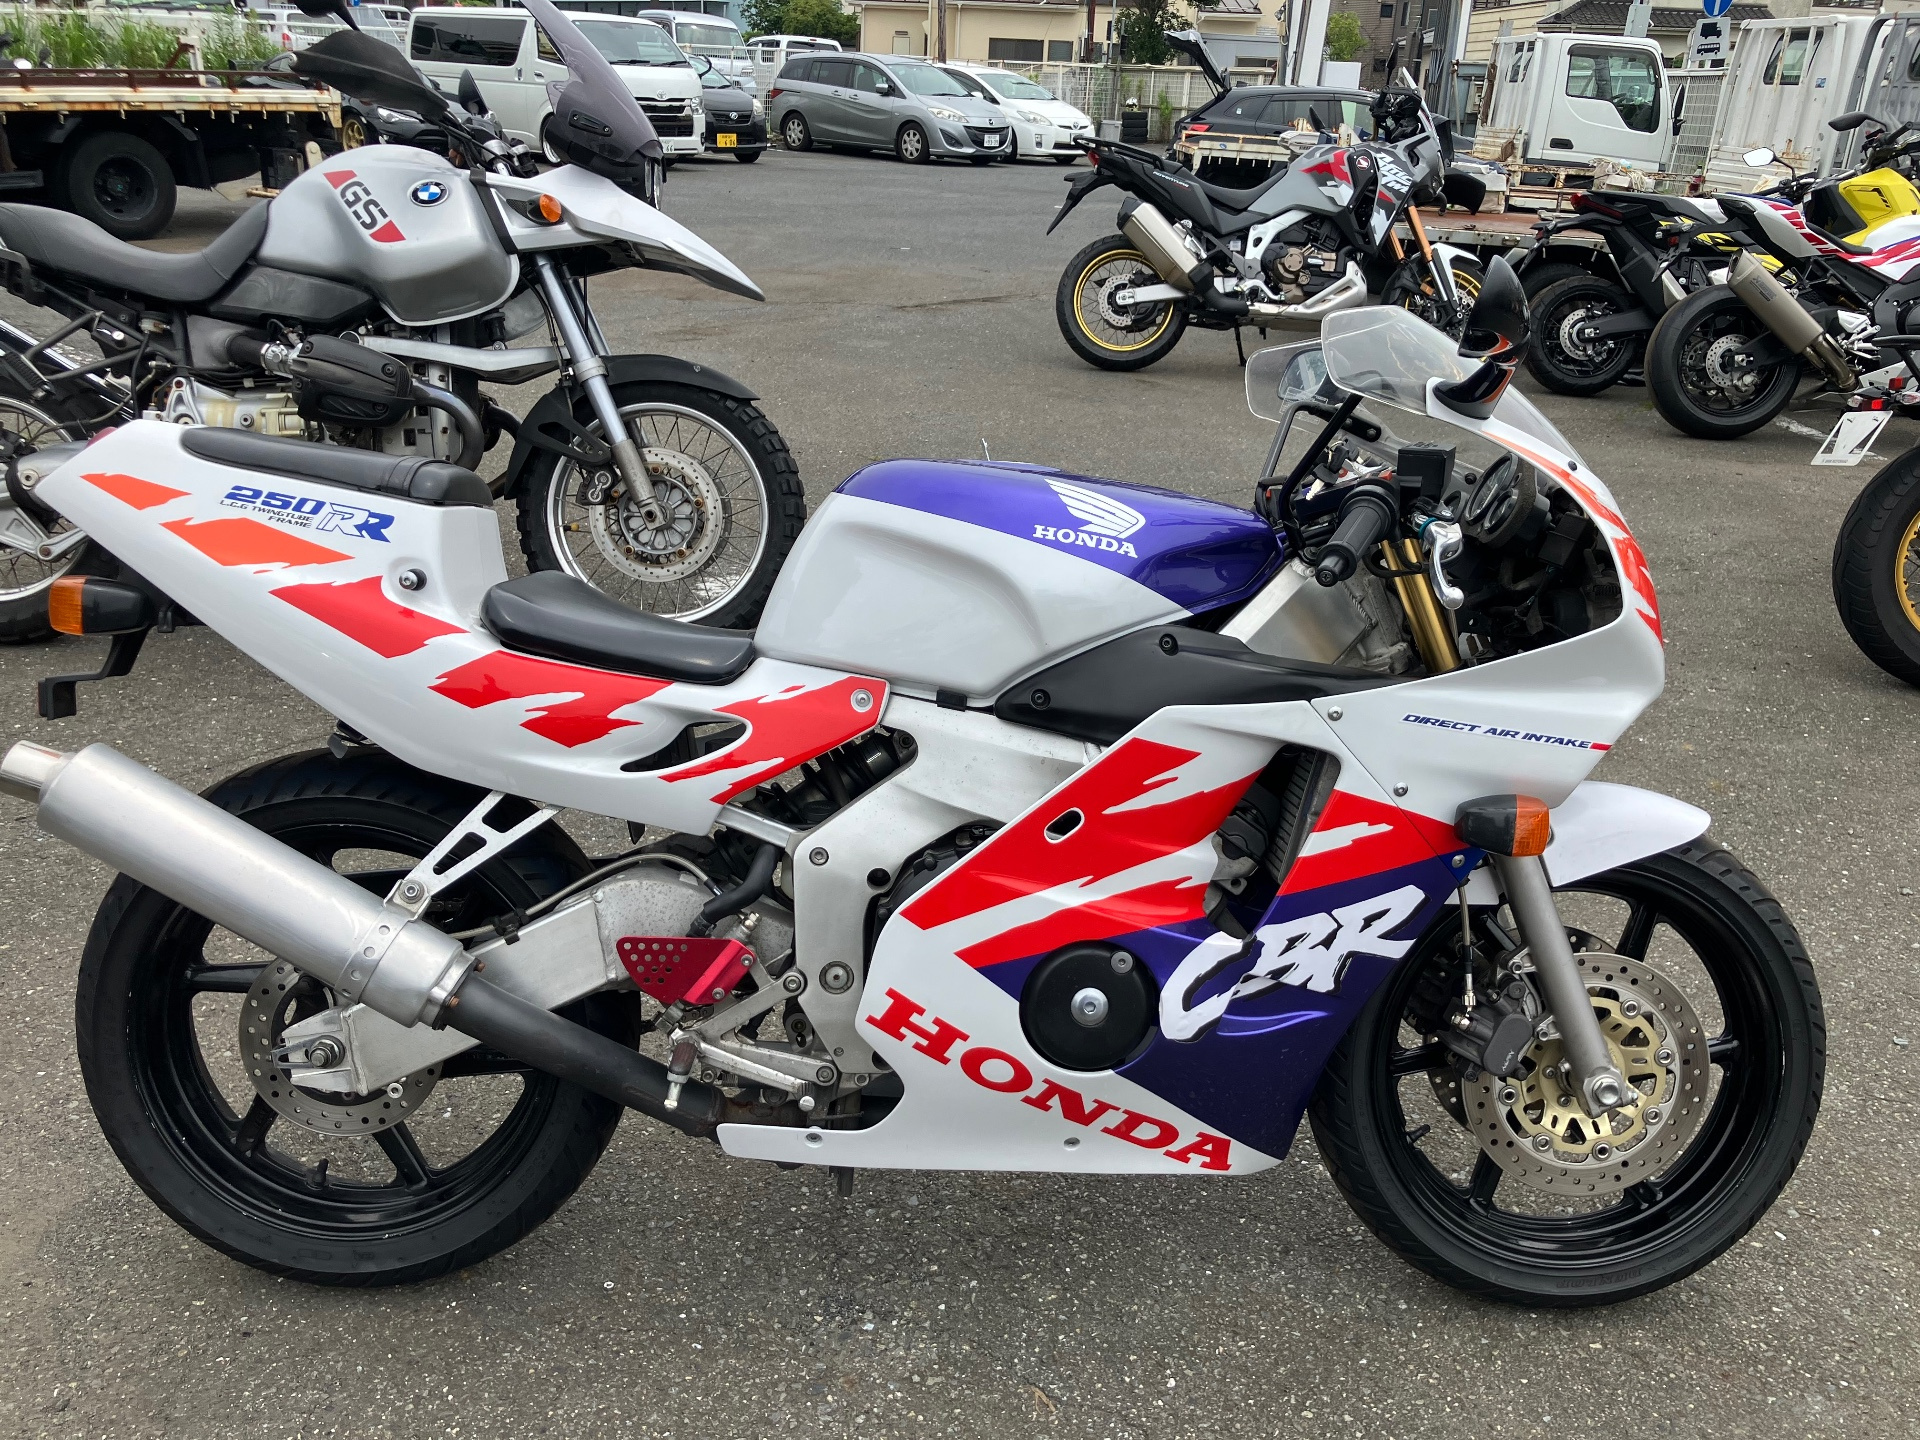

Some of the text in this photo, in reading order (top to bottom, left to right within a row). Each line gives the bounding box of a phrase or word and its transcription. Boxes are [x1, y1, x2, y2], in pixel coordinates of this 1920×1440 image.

[340, 180, 389, 230] GS
[268, 515, 312, 529] FRAME
[1032, 524, 1139, 559] HONDA
[1402, 713, 1592, 749] DIRECT AIR INTAKE
[1159, 884, 1431, 1043] CBR
[864, 986, 1233, 1171] HONDA
